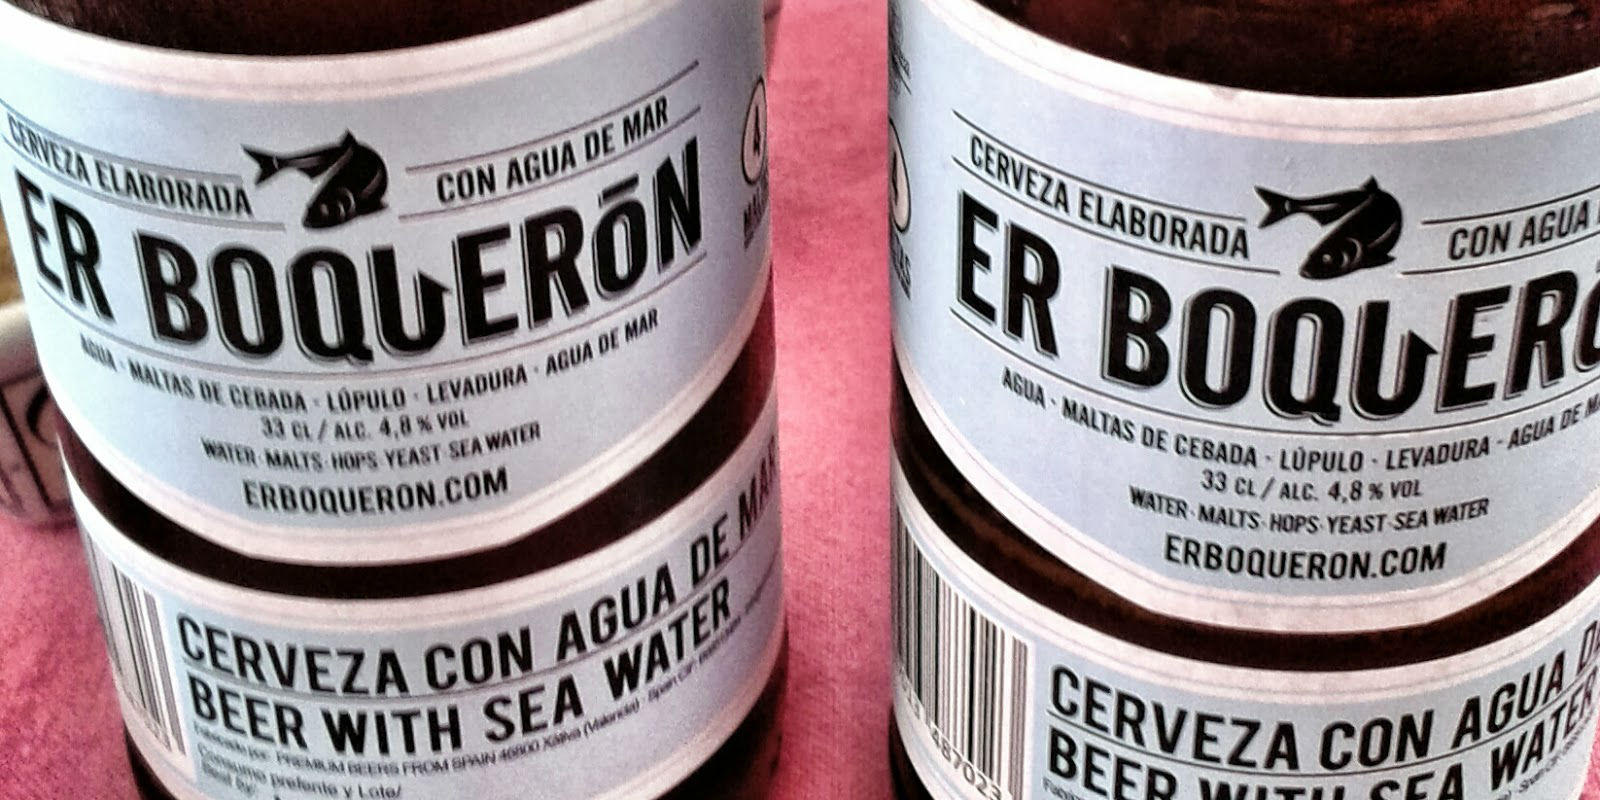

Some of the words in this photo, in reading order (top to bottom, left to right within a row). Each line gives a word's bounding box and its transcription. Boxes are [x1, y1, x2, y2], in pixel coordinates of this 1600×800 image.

[7, 111, 92, 187] CERVEZA
[93, 158, 253, 217] ELABORADA
[436, 161, 497, 204] CON
[506, 139, 578, 190] AGUA
[583, 122, 615, 164] DE
[621, 95, 669, 146] MAR
[969, 133, 1070, 215] CERVEZA
[1078, 187, 1250, 260] ELABORADA
[14, 166, 117, 324] ER
[955, 188, 1061, 361] ER
[1449, 219, 1511, 261] CON
[1519, 199, 1590, 249] AGUA
[80, 333, 118, 373] AGUA
[127, 358, 196, 400] MALTAS
[200, 379, 221, 403] DE
[229, 383, 308, 413] CEBADA
[326, 386, 406, 414] LÚPULO
[426, 363, 528, 405] LEVADURA
[545, 338, 594, 377] AGUA
[599, 328, 619, 354] DE
[624, 307, 659, 343] MAR
[201, 437, 257, 468] WATER
[331, 450, 378, 472] HOPS
[384, 443, 441, 469] YEAST
[449, 433, 483, 460] SEA
[485, 420, 542, 452] WATER
[260, 415, 286, 440] 33
[291, 420, 312, 440] CL
[334, 420, 371, 440] ALC.
[378, 413, 412, 442] 4,8
[436, 408, 471, 430] VOL
[1002, 365, 1047, 409] AGUA
[1062, 396, 1135, 442] MALTAS
[1140, 427, 1168, 452] DE
[1174, 433, 1258, 468] CEBADA
[1279, 446, 1363, 473] LÚPULO
[1384, 436, 1490, 470] LEVADURA
[1507, 415, 1555, 450] AGUA
[1560, 402, 1583, 431] DE
[242, 465, 510, 515] ERBOQUERON.COM
[1129, 484, 1189, 520] WATER
[1198, 505, 1261, 530] MALTS
[1269, 512, 1320, 534] HOPS
[1327, 513, 1387, 535] YEAST
[1393, 510, 1428, 531] SEA
[1433, 498, 1490, 526] WATER
[1201, 468, 1227, 492] 33
[1234, 477, 1255, 496] CL
[1279, 481, 1318, 501] ALC.
[1327, 479, 1363, 504] 4,8
[1390, 479, 1424, 499] VOL
[176, 611, 410, 696] CERVEZA
[424, 624, 535, 692] CON
[555, 561, 678, 664] AGUA
[689, 512, 731, 590] DE
[1164, 532, 1448, 580] ERBOQUERON.COM
[187, 669, 308, 750] BEER
[320, 703, 463, 756] WITH
[482, 672, 585, 744] SEA
[602, 576, 733, 702] WATER
[1051, 664, 1300, 771] CERVEZA
[1319, 708, 1436, 771] CON
[1451, 649, 1566, 750] AGUA
[1048, 724, 1179, 800] BEER
[1491, 665, 1600, 792] WATER
